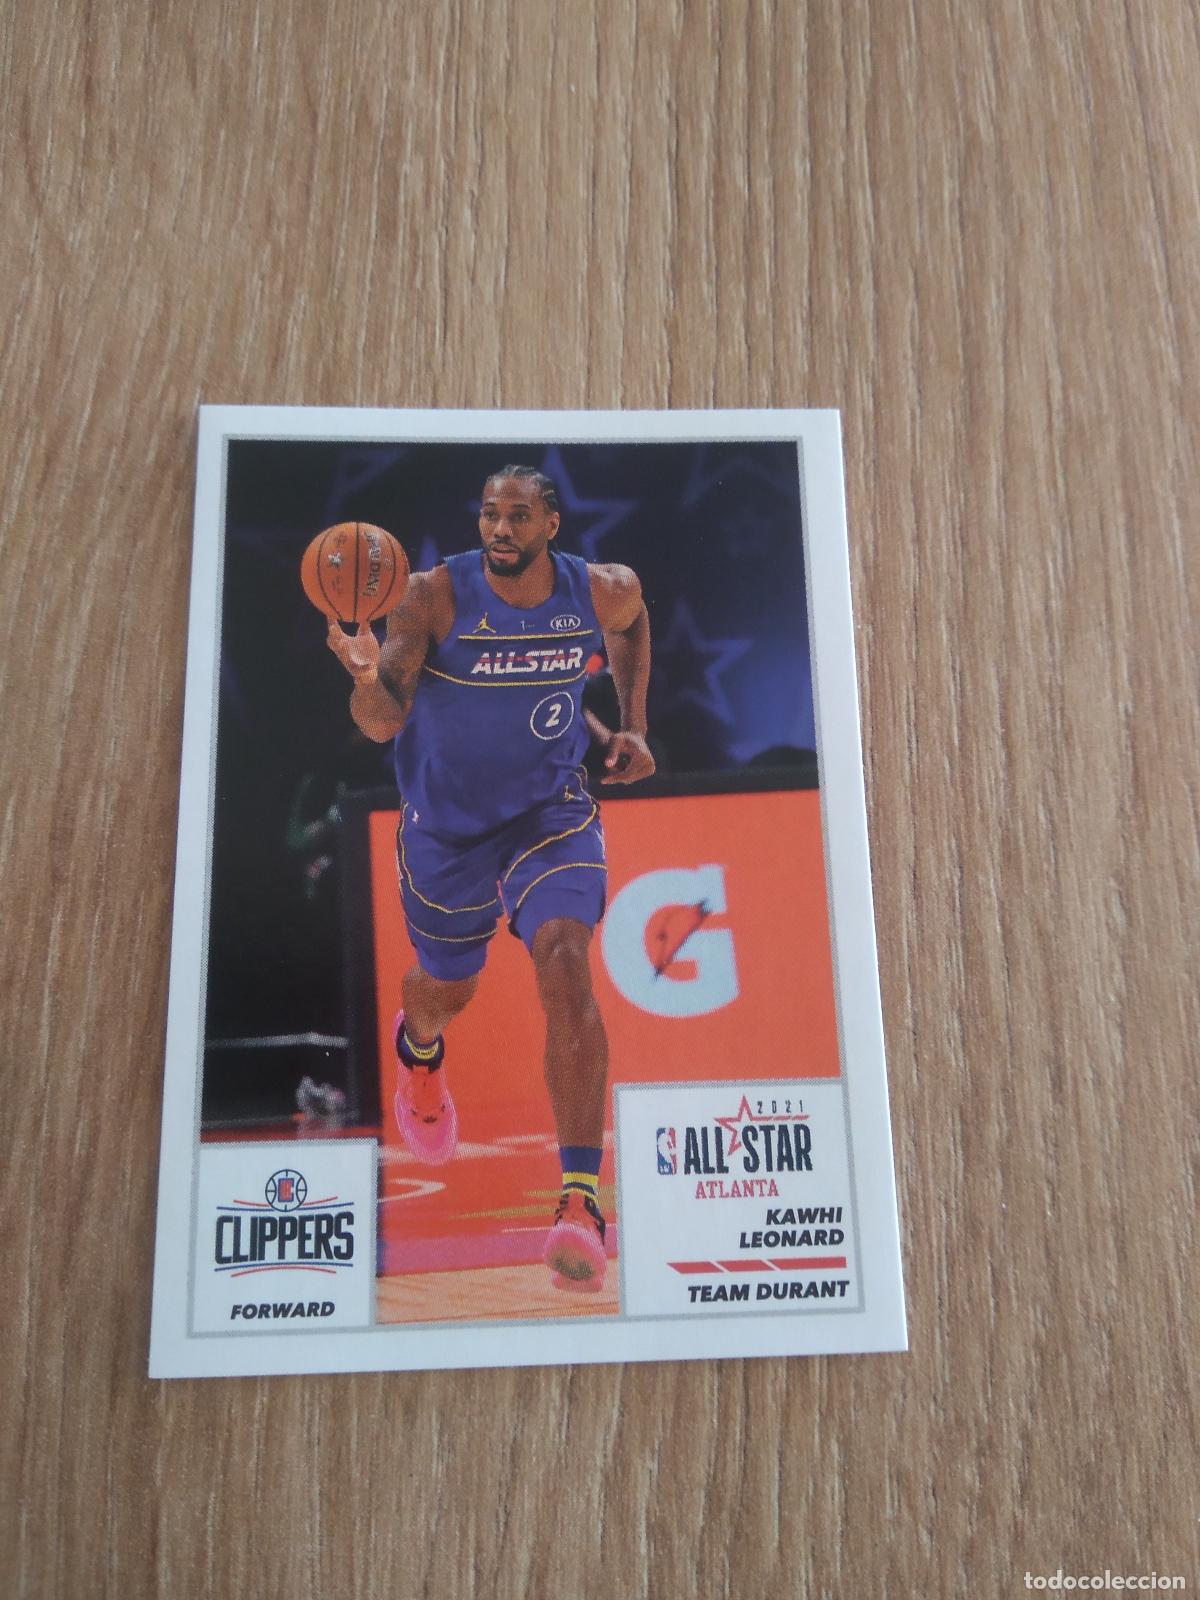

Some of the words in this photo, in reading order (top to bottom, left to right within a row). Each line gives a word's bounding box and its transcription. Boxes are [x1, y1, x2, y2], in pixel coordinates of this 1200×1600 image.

[555, 616, 577, 629] KIA
[545, 703, 562, 728] 2
[602, 863, 740, 1019] G
[757, 1099, 804, 1114] 2021
[695, 1179, 779, 1199] ATLANTA
[766, 1207, 842, 1226] KAWHI
[215, 1211, 354, 1264] CLIPPERS
[739, 1229, 845, 1249] LEONARD
[688, 1284, 750, 1303] TEAM
[756, 1280, 850, 1300] DURANT
[230, 1301, 335, 1320] FORWARD
